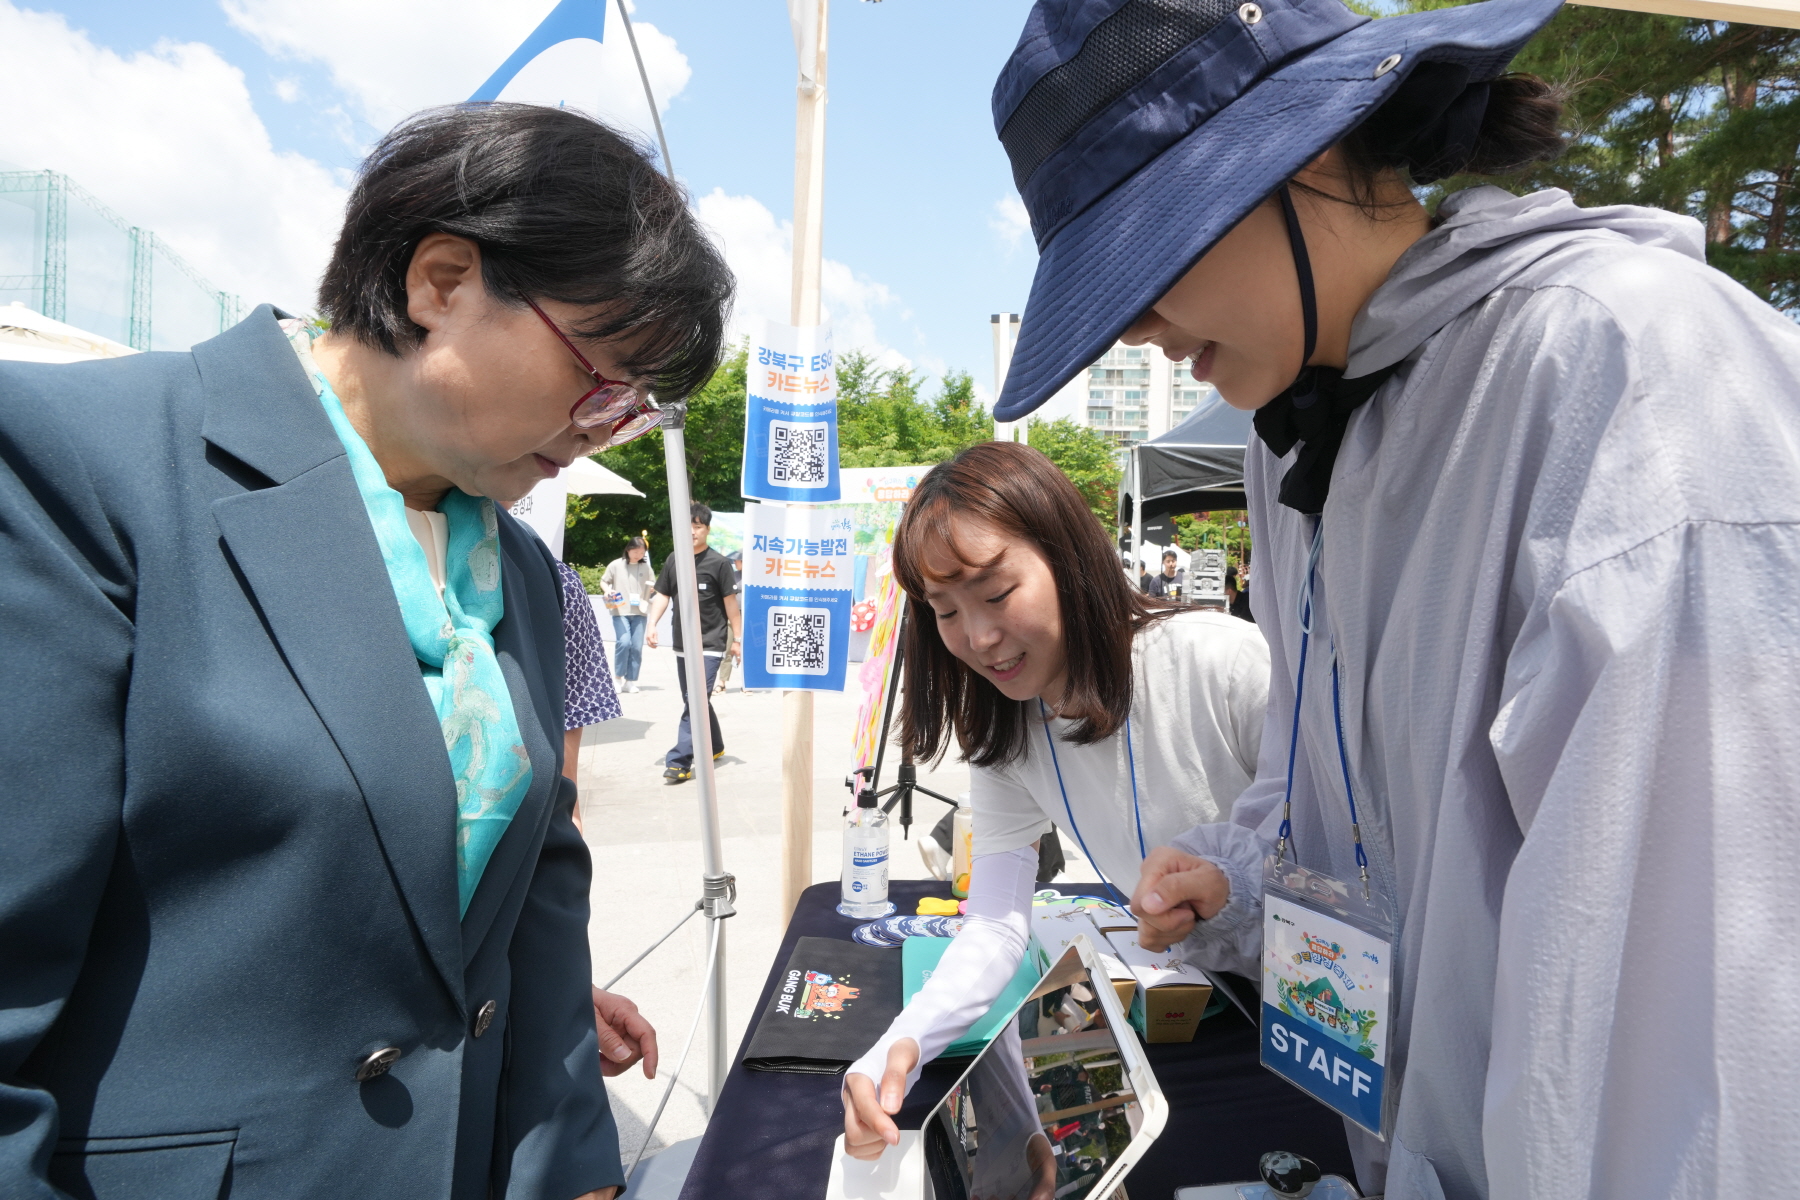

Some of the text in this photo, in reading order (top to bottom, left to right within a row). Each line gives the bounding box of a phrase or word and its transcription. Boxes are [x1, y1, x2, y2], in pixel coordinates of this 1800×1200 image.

[758, 346, 832, 372] 강북구 ESG
[767, 370, 830, 394] 카드뉴스
[752, 534, 847, 557] 지속가능발전
[765, 557, 836, 579] 카드뉴스
[921, 970, 933, 984] GA
[775, 969, 802, 1015] GANG BUK
[1270, 1022, 1372, 1098] STAFF
